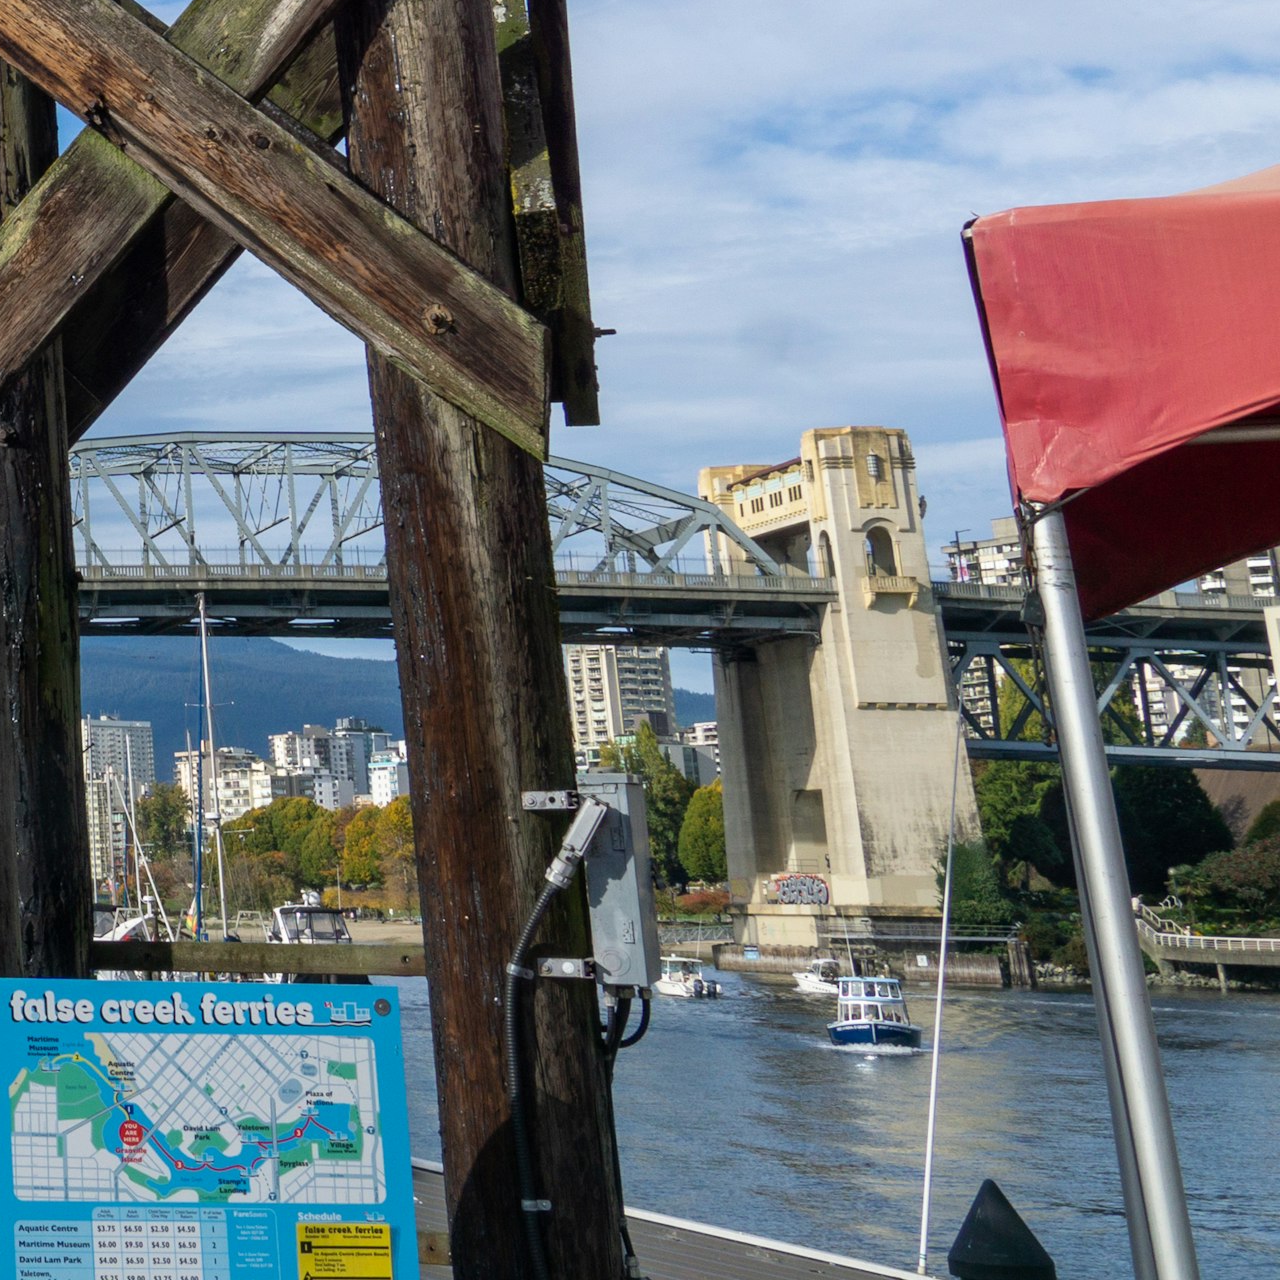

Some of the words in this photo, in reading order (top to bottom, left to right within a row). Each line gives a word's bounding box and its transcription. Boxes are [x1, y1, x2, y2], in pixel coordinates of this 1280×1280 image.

[9, 989, 95, 1023] false
[100, 992, 195, 1025] creek
[200, 992, 314, 1025] ferries
[237, 1124, 270, 1132] Yaletown
[279, 1160, 309, 1168] Spyglass
[218, 1178, 247, 1186] Stamp's
[219, 1187, 247, 1195] Landing
[298, 1212, 342, 1221] Schedule
[18, 1225, 49, 1233] Aquatic
[97, 1225, 116, 1233] $3.75
[124, 1225, 142, 1233] $6.50
[150, 1225, 169, 1233] $2.50
[305, 1226, 325, 1234] false
[355, 1226, 383, 1234] ferries
[18, 1240, 55, 1248] Maritime
[19, 1256, 42, 1264] David
[43, 1256, 61, 1264] Lam
[63, 1256, 82, 1264] Park
[152, 1257, 171, 1265] $2.50
[179, 1257, 198, 1265] $4.50
[20, 1269, 52, 1277] Yaletown,
